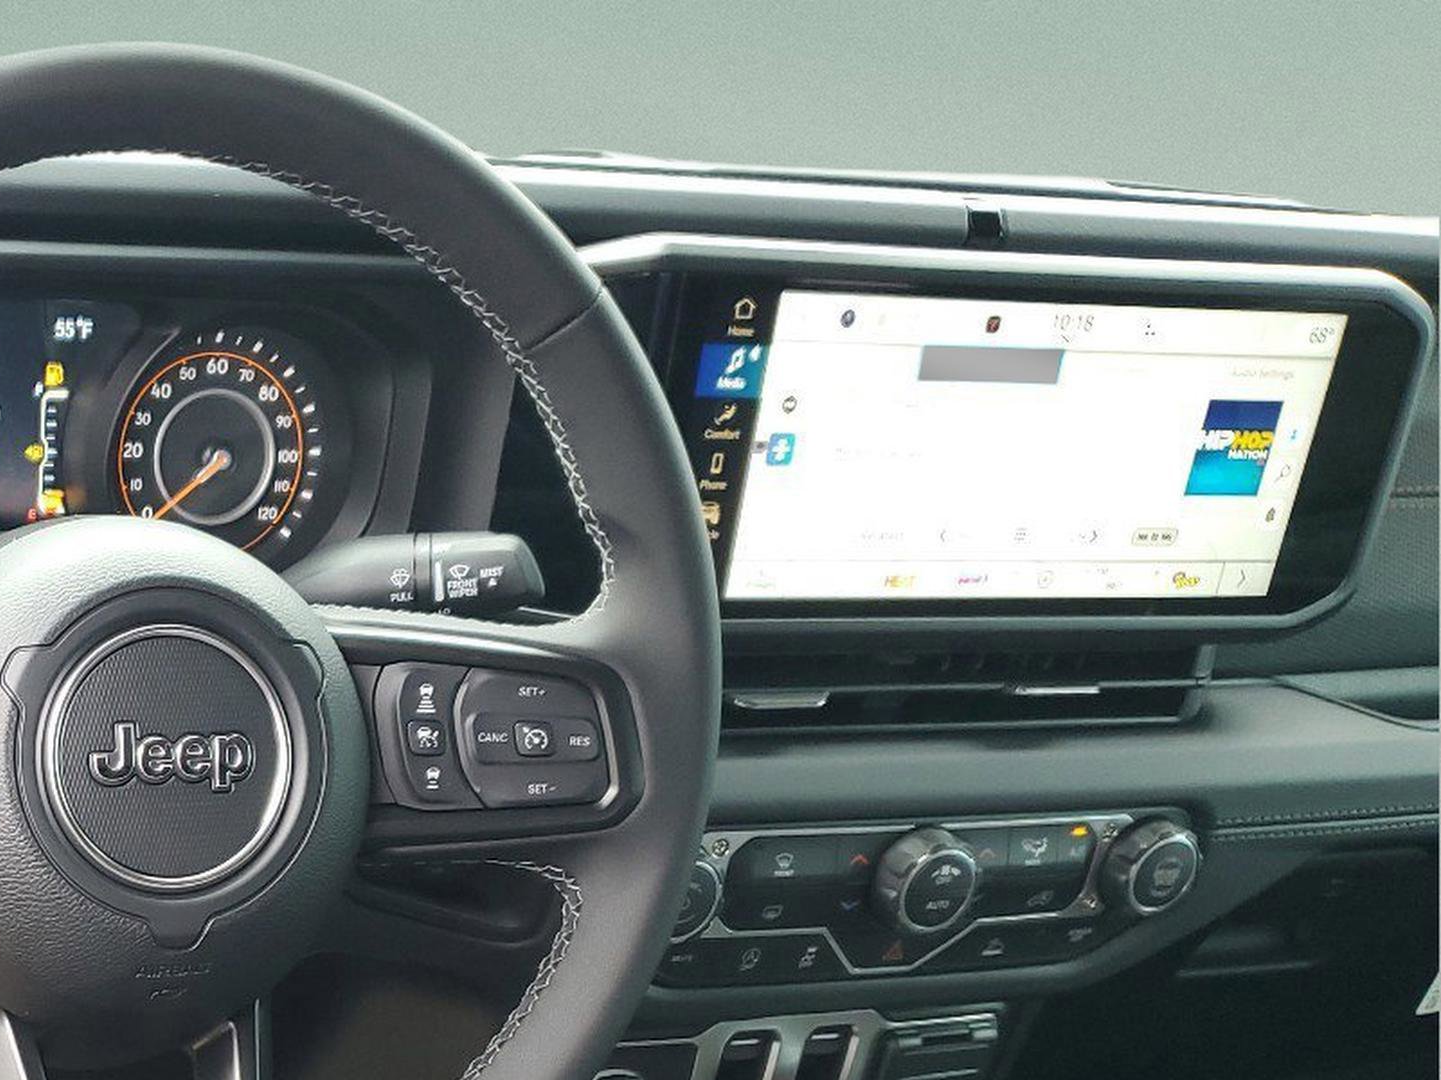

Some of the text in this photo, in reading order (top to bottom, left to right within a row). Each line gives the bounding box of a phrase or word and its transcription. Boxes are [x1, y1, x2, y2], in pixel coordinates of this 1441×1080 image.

[207, 359, 229, 374] 60
[179, 367, 196, 380] 50
[239, 369, 255, 381] 70
[151, 383, 172, 398] 40
[259, 386, 279, 401] 80
[135, 412, 151, 425] 30
[276, 416, 291, 428] 90
[123, 443, 143, 458] 20
[278, 449, 298, 463] 100
[1227, 449, 1268, 461] NATION
[131, 478, 143, 490] 10
[274, 480, 290, 493] 110
[142, 507, 153, 519] 0
[258, 507, 277, 519] 120
[447, 578, 478, 589] FRONT
[390, 592, 414, 602] PULL
[478, 732, 509, 743] CANC
[569, 736, 591, 747] RES
[90, 720, 255, 792] Jeep
